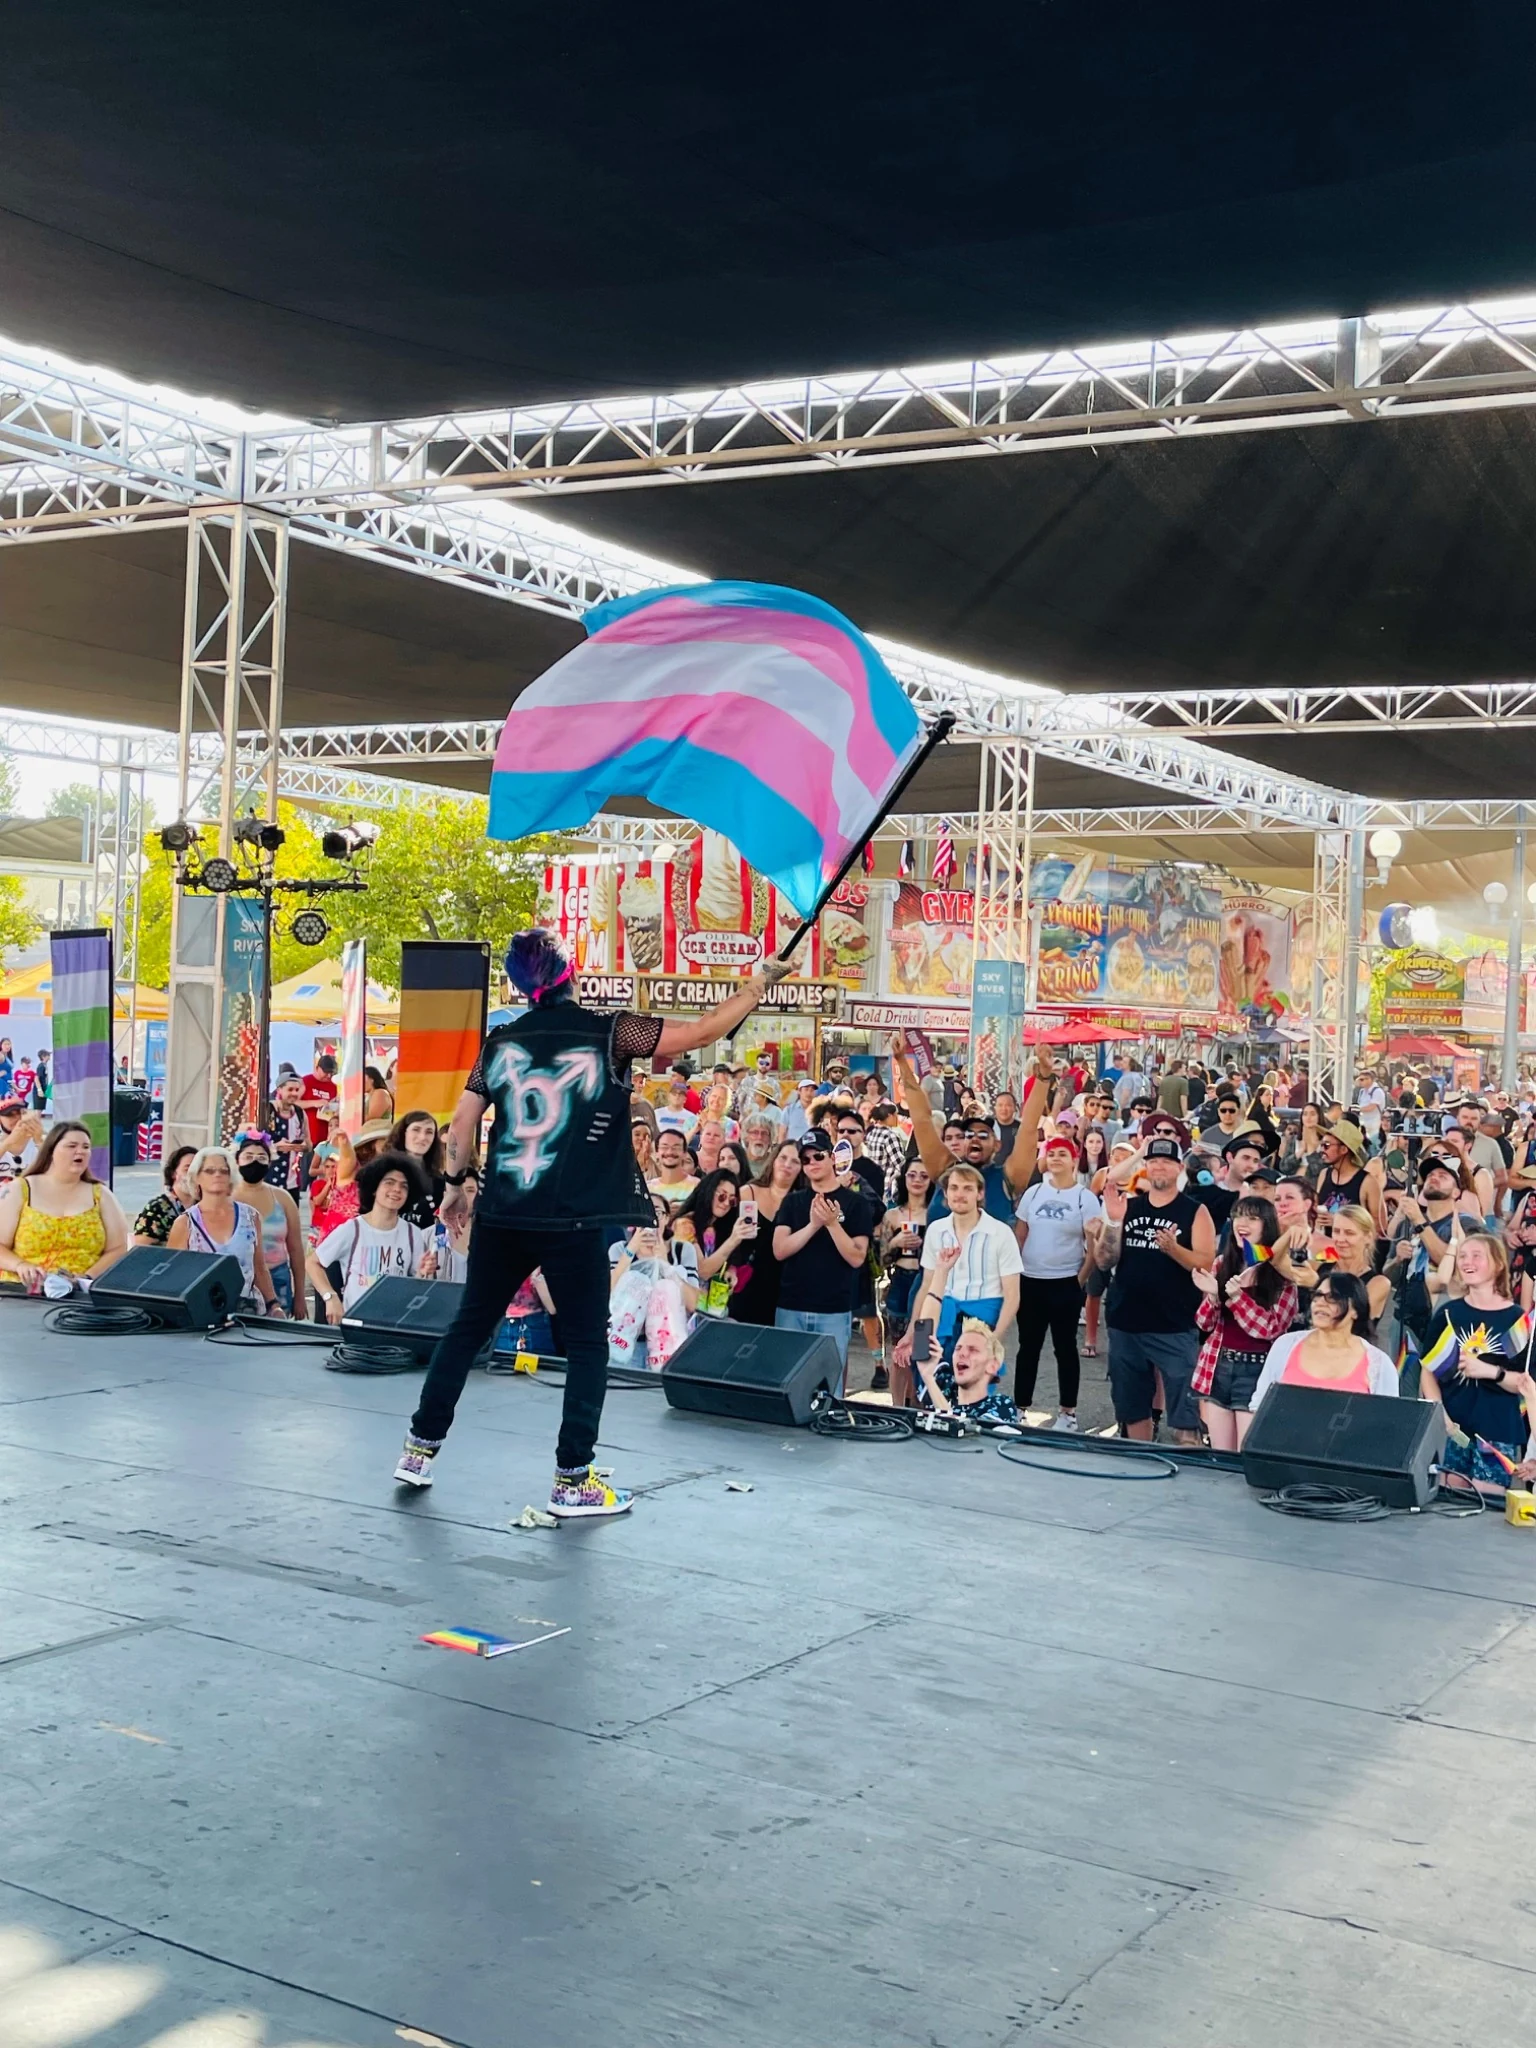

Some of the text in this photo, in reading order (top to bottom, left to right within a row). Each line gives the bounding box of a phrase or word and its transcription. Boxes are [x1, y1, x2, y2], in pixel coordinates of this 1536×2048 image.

[557, 886, 589, 920] ICE
[1048, 902, 1103, 937] VEGGIES
[705, 933, 737, 941] OLDE
[233, 939, 264, 953] RIVE
[684, 941, 758, 956] ICE CREAM
[982, 973, 1001, 982] SKY
[1055, 956, 1100, 992] RINGS
[579, 977, 633, 998] CONES
[650, 981, 674, 1002] ICE
[977, 984, 1005, 994] RIVER
[1391, 990, 1458, 999] SANDWICHES
[855, 1008, 882, 1023] Cold
[885, 1010, 917, 1026] Drinks
[1125, 1238, 1147, 1248] CLEAN
[360, 1245, 405, 1276] KUM &
